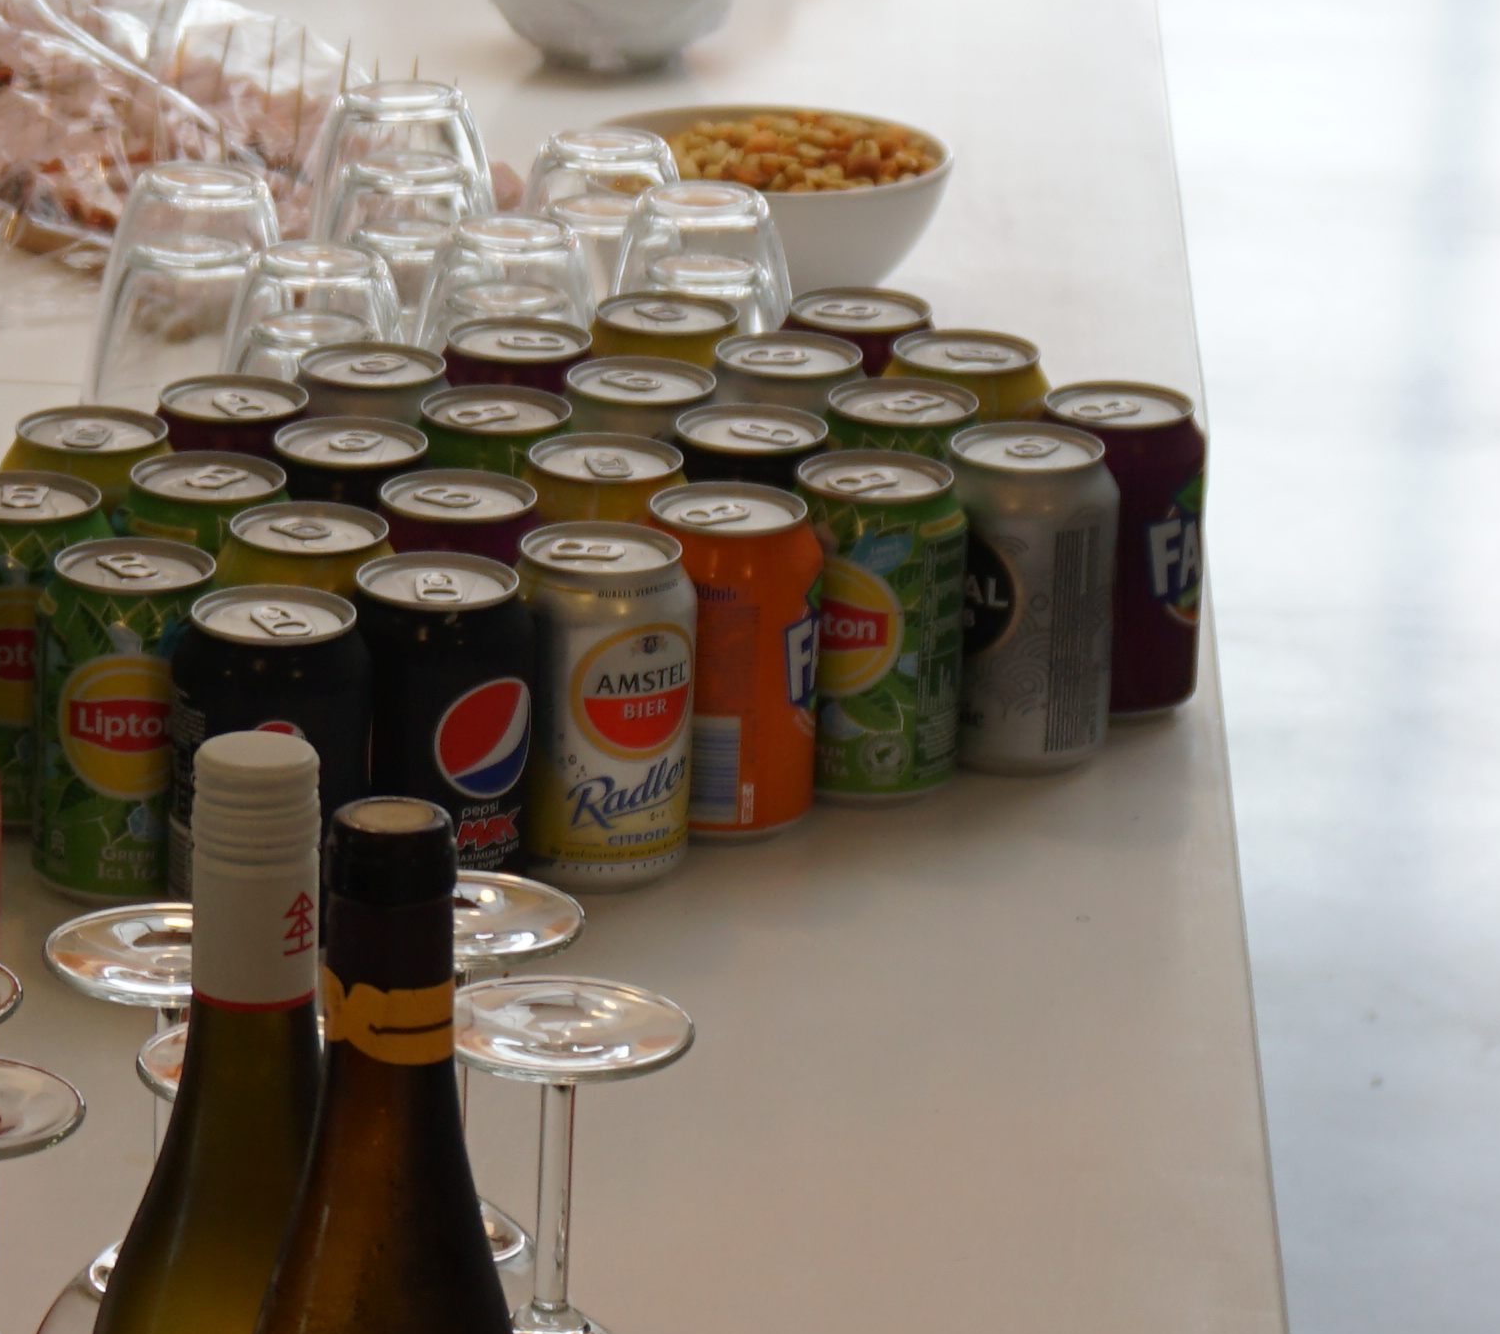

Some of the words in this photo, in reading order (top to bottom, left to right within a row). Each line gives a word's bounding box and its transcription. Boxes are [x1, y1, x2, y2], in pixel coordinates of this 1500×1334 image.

[596, 661, 686, 695] AMSTEL
[78, 707, 171, 742] Lipto
[622, 698, 667, 721] BIER
[461, 800, 499, 819] pepsi
[566, 756, 687, 830] Radler
[456, 805, 523, 851] MAX
